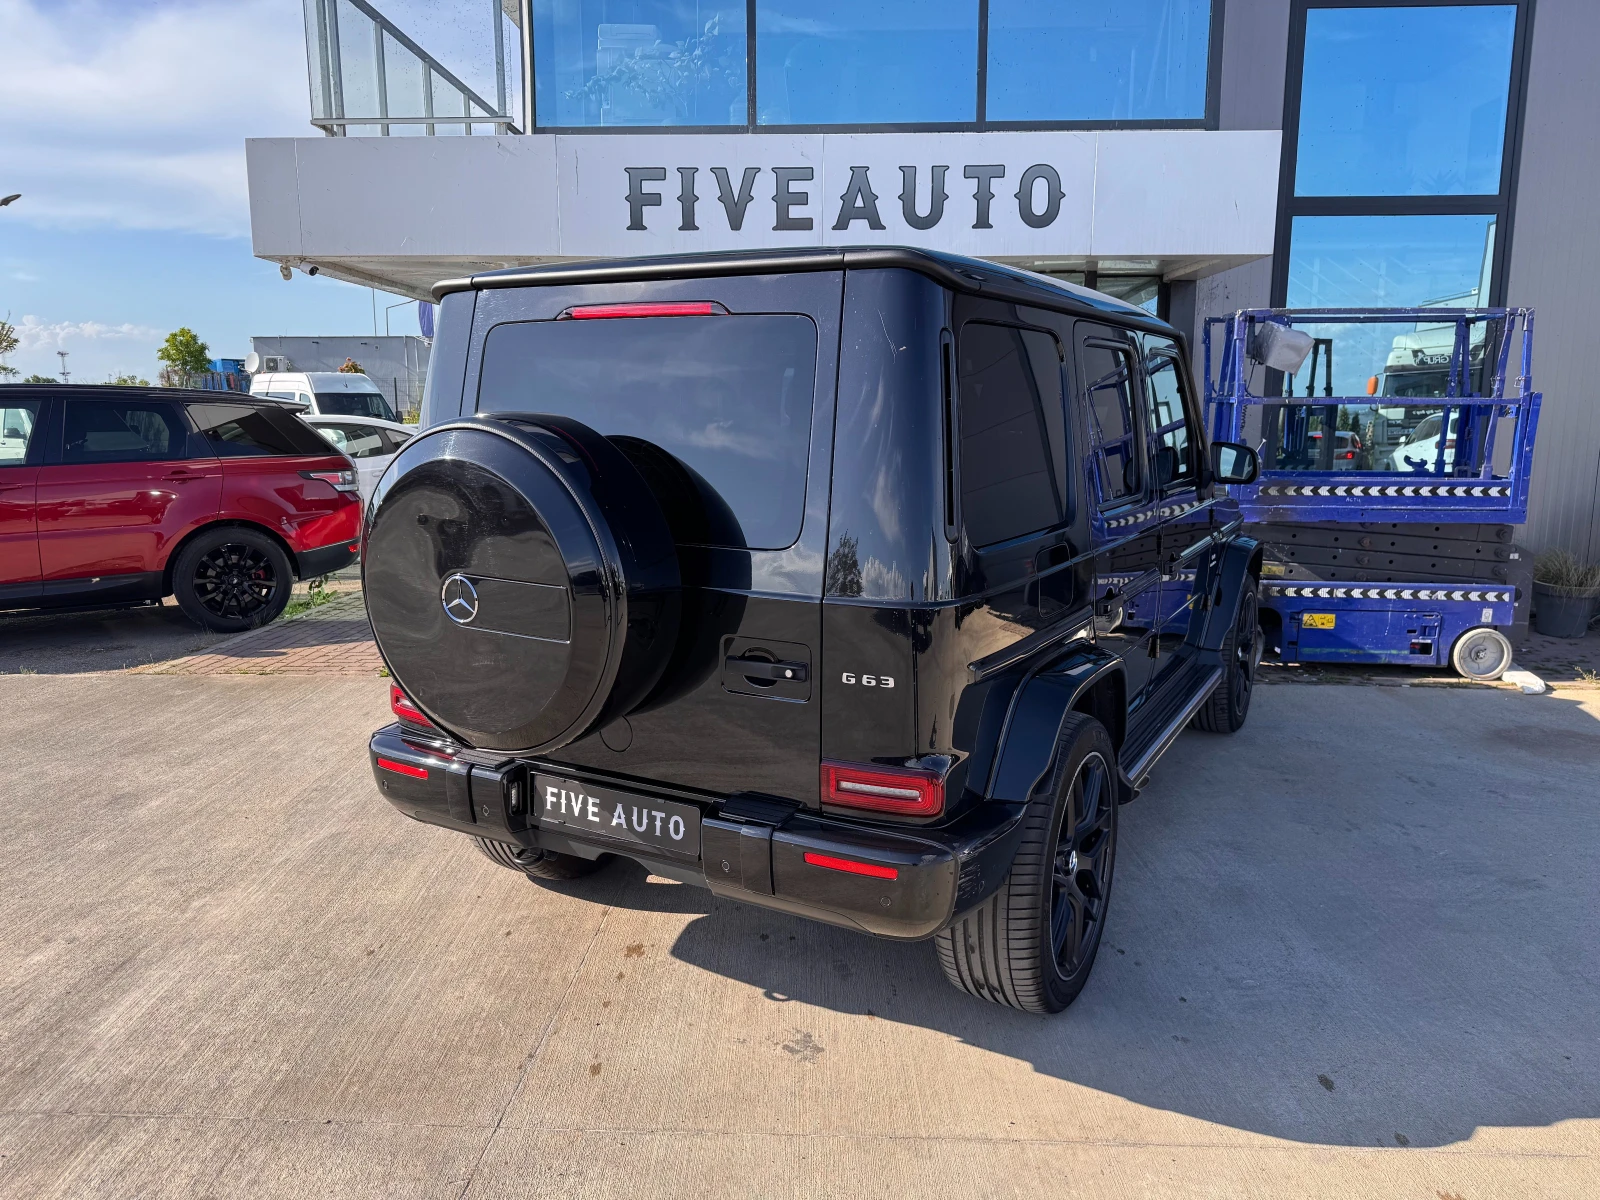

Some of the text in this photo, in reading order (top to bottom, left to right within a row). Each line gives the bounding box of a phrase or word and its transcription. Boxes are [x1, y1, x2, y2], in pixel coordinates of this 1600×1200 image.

[624, 163, 1067, 231] FIVE AUTO
[545, 785, 686, 841] FIVE AUTO
